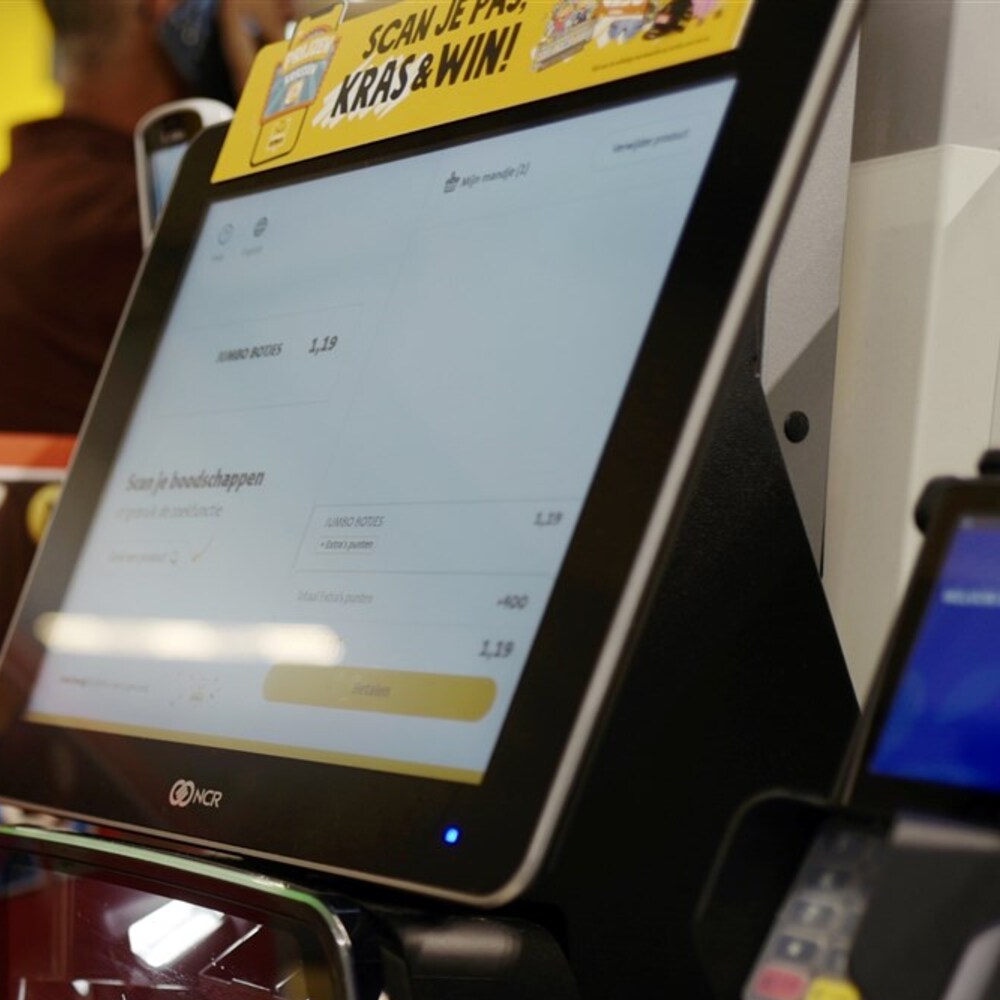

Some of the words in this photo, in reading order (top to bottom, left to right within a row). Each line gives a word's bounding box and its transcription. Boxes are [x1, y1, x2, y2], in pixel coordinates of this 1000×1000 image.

[362, 5, 437, 60] SCAN
[434, 0, 465, 36] JE
[308, 335, 339, 356] 1,19
[126, 473, 153, 491] Scan
[152, 471, 169, 496] je
[169, 468, 265, 493] boodschappen
[533, 511, 563, 527] 1,19
[478, 639, 515, 660] 1,19
[192, 788, 223, 808] NCR
